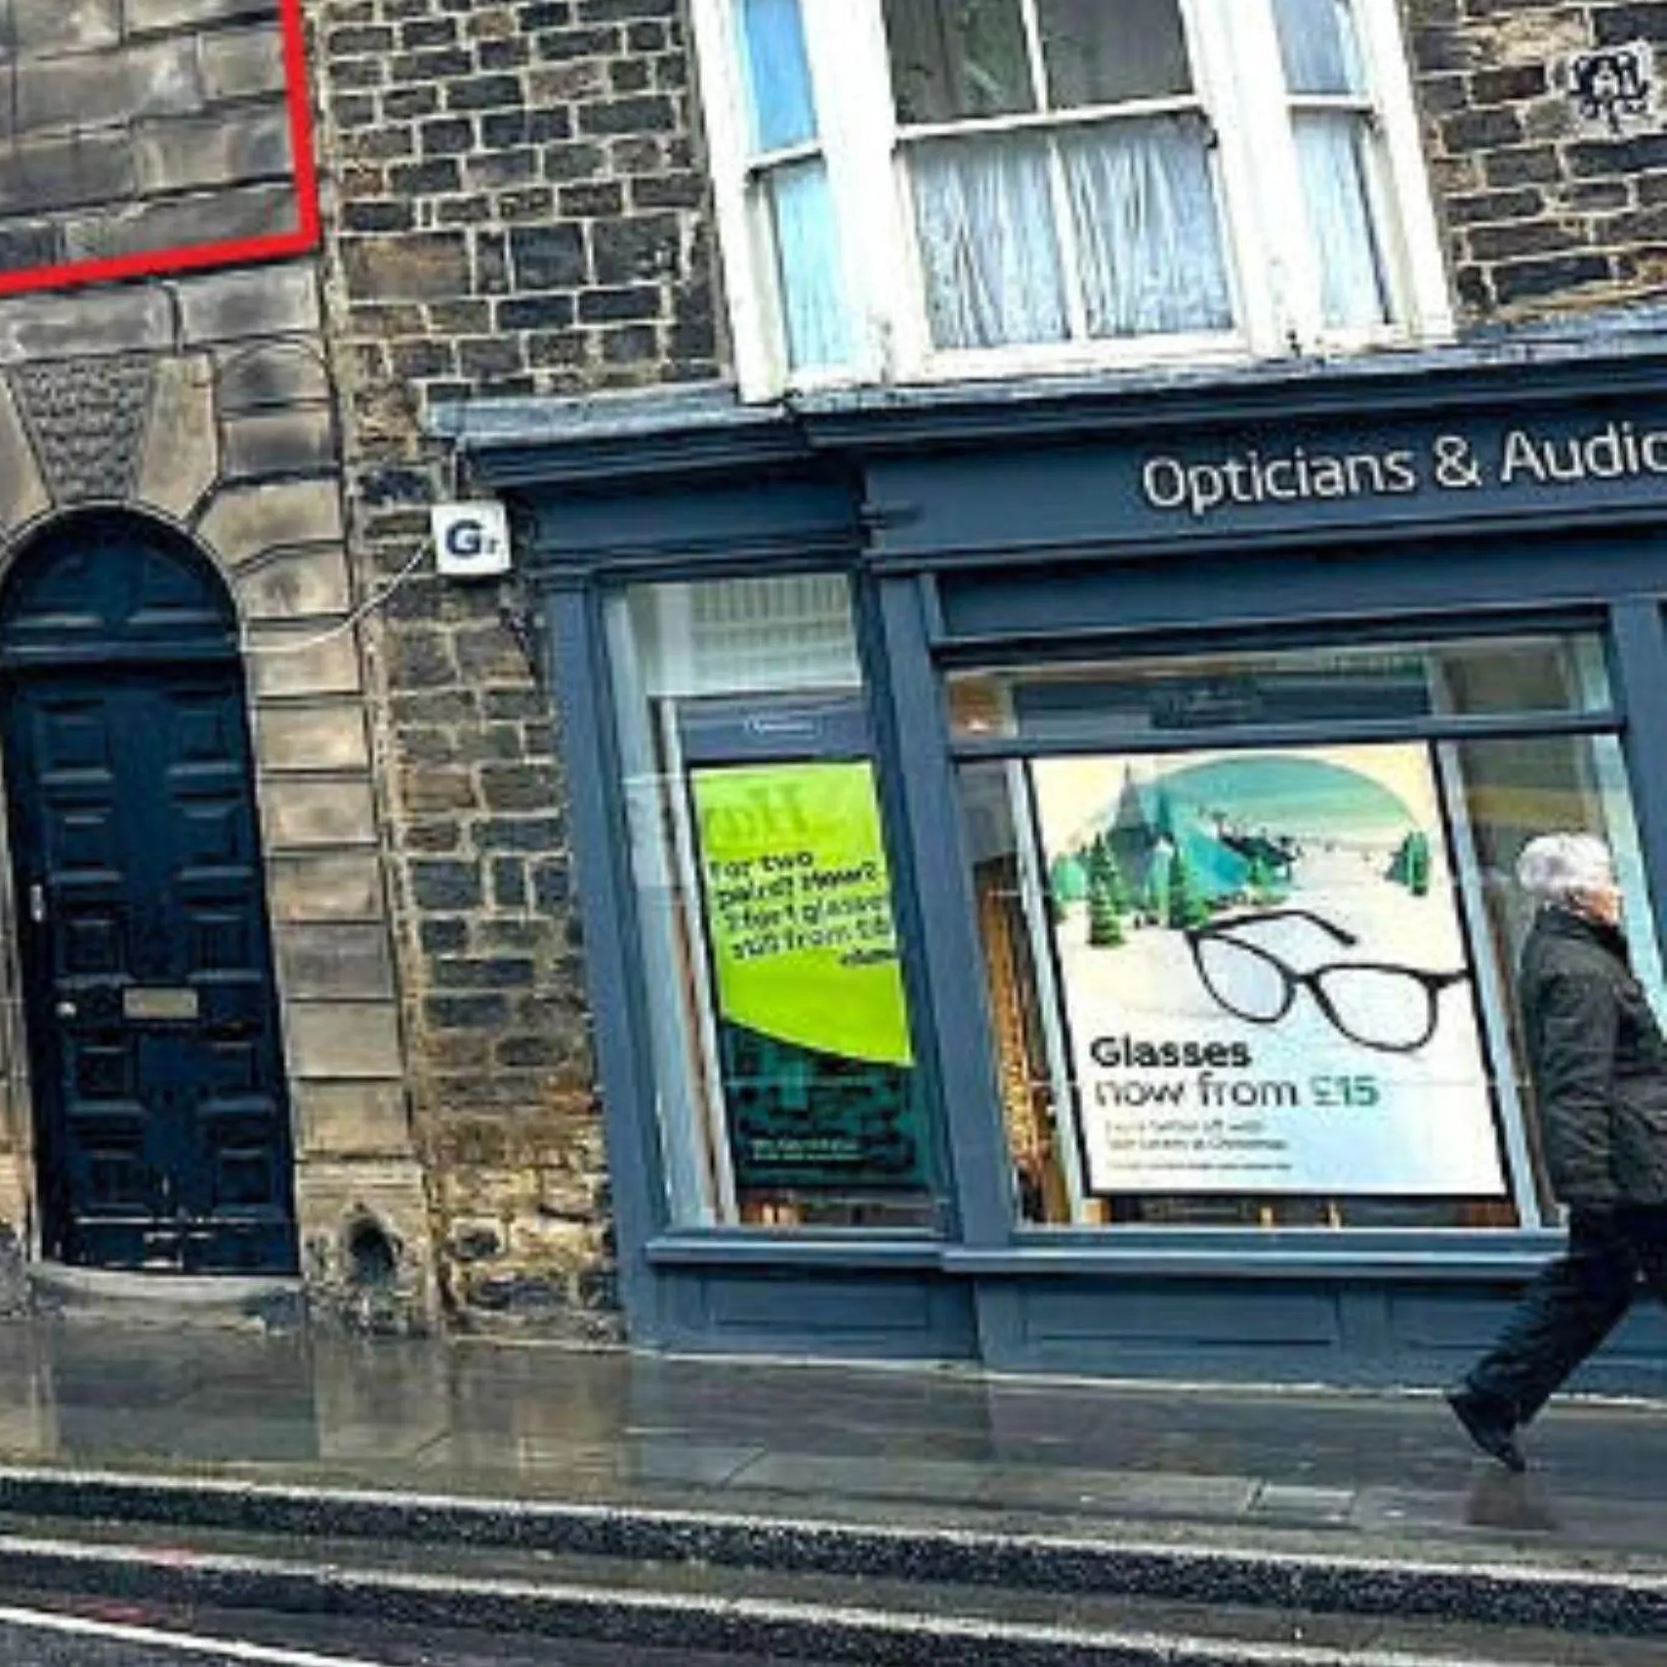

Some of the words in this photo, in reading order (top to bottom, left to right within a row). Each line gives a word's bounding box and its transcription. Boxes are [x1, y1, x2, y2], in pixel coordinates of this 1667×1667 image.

[1142, 446, 1416, 515] Opticians
[1432, 433, 1483, 489] &
[761, 850, 813, 872] two
[1089, 1035, 1253, 1068] Glasses
[1094, 1080, 1185, 1107] now
[1196, 1070, 1299, 1107] from
[1309, 1074, 1380, 1108] £15
